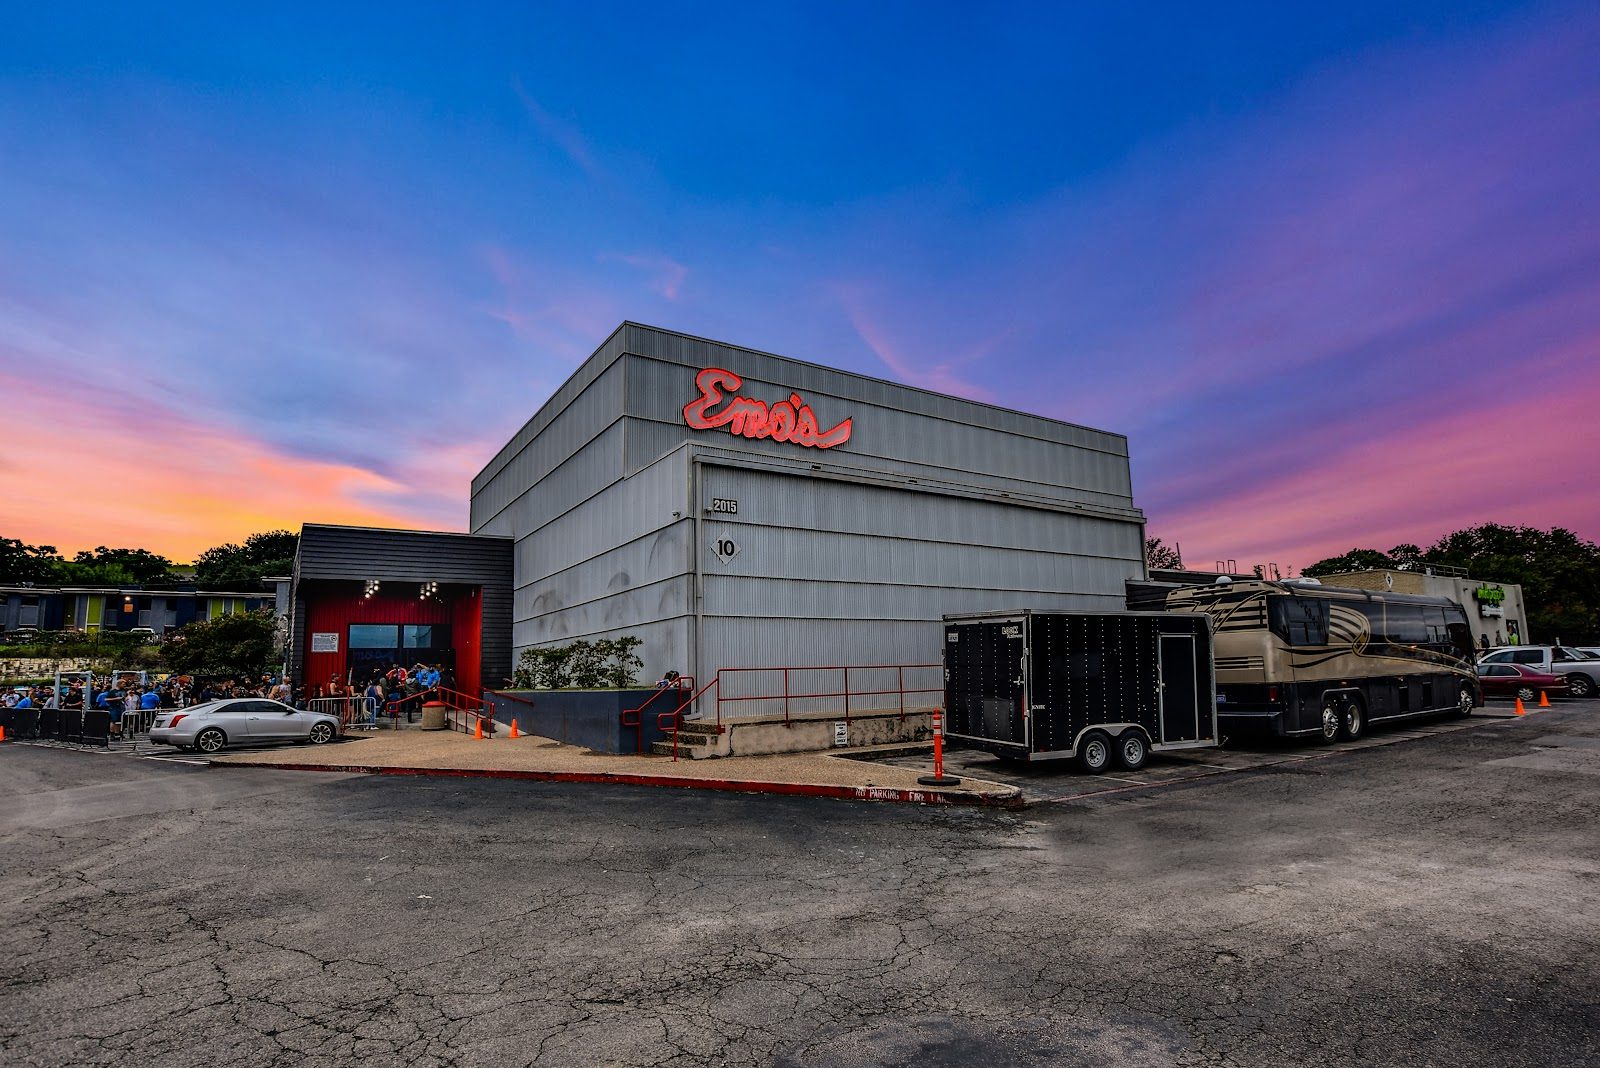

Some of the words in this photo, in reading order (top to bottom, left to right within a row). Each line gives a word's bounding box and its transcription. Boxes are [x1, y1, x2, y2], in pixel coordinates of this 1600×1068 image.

[683, 367, 852, 448] Emo's
[713, 499, 737, 513] 2015
[717, 540, 735, 556] 10
[855, 787, 866, 797] NO
[869, 788, 899, 800] PARKING
[908, 791, 925, 802] FIRE
